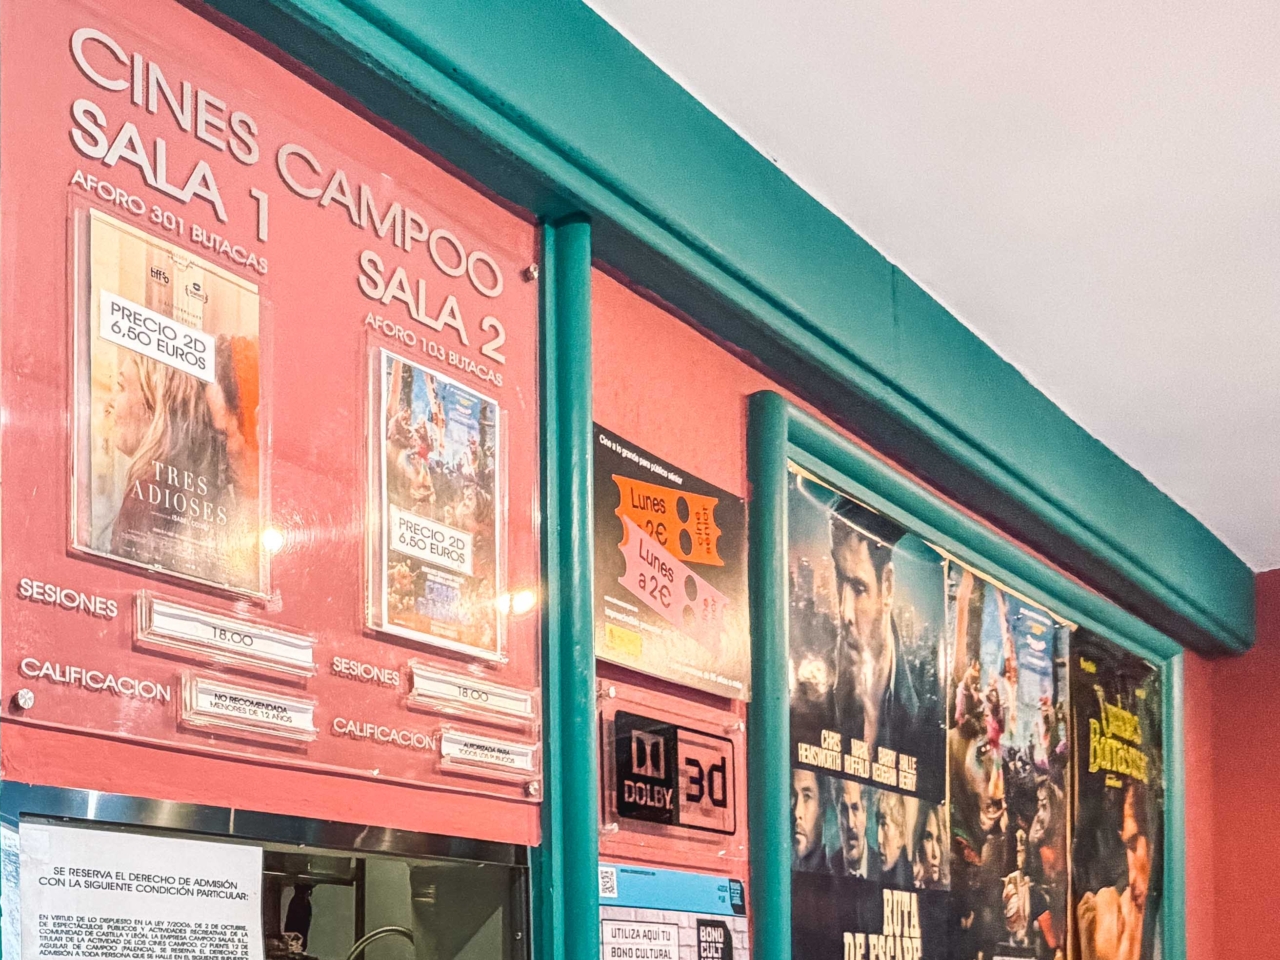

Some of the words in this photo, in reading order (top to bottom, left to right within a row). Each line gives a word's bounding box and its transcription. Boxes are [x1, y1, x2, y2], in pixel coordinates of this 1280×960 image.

[71, 26, 261, 166] CINES
[276, 142, 505, 299] CAMPOO
[71, 98, 228, 223] SALA
[249, 186, 269, 242] 1
[71, 169, 145, 217] AFORO
[151, 204, 185, 237] 301
[192, 224, 269, 275] BUTACAS
[358, 249, 469, 347] SALA
[481, 316, 507, 365] 2
[109, 319, 154, 352] 6,50
[156, 338, 207, 372] EUROS
[110, 301, 178, 343] PRECIO
[182, 332, 207, 355] 2D
[364, 312, 418, 348] AFORO
[420, 339, 446, 363] 103
[448, 351, 504, 388] BUTACAS
[599, 434, 611, 448] Cine
[152, 460, 208, 496] TRES
[130, 480, 227, 526] ADIOSES
[631, 487, 666, 514] Lunes
[398, 516, 446, 544] PRECIO
[448, 535, 466, 551] 2D
[398, 532, 427, 554] 6,50
[429, 542, 466, 565] EUROS
[639, 538, 674, 583] Lunes
[19, 577, 119, 619] SESIONES
[638, 573, 646, 591] a
[650, 576, 672, 609] 2€
[212, 627, 253, 647] 18.00
[20, 657, 171, 703] CALIFICACION
[332, 656, 401, 688] SESIONES
[210, 701, 247, 715] MENORES
[249, 708, 258, 716] DE
[215, 693, 227, 702] NO
[229, 696, 288, 714] RECOMENDADA
[332, 717, 437, 752] CALIFICACION
[821, 729, 842, 751] CHRIS
[624, 779, 673, 810] DOLBY
[685, 756, 727, 809] 3d
[39, 877, 65, 887] CON
[69, 879, 81, 889] LA
[84, 879, 133, 892] SIGUIENTE
[136, 883, 194, 897] CONDICIÓN
[196, 889, 249, 901] PARTICULAR:
[54, 867, 66, 876] SE
[69, 868, 112, 880] RESERVA
[115, 871, 126, 881] EL
[129, 873, 175, 885] DERECHO
[178, 877, 191, 886] DE
[193, 879, 238, 890] ADMISIÓN
[883, 888, 921, 938] RUTA
[611, 928, 640, 940] UTILIZA
[643, 928, 660, 942] AQUÍ
[661, 930, 670, 941] TU
[700, 927, 724, 941] BONO
[700, 942, 724, 957] CULT
[611, 947, 633, 958] BONO
[635, 948, 672, 960] CULTURAL
